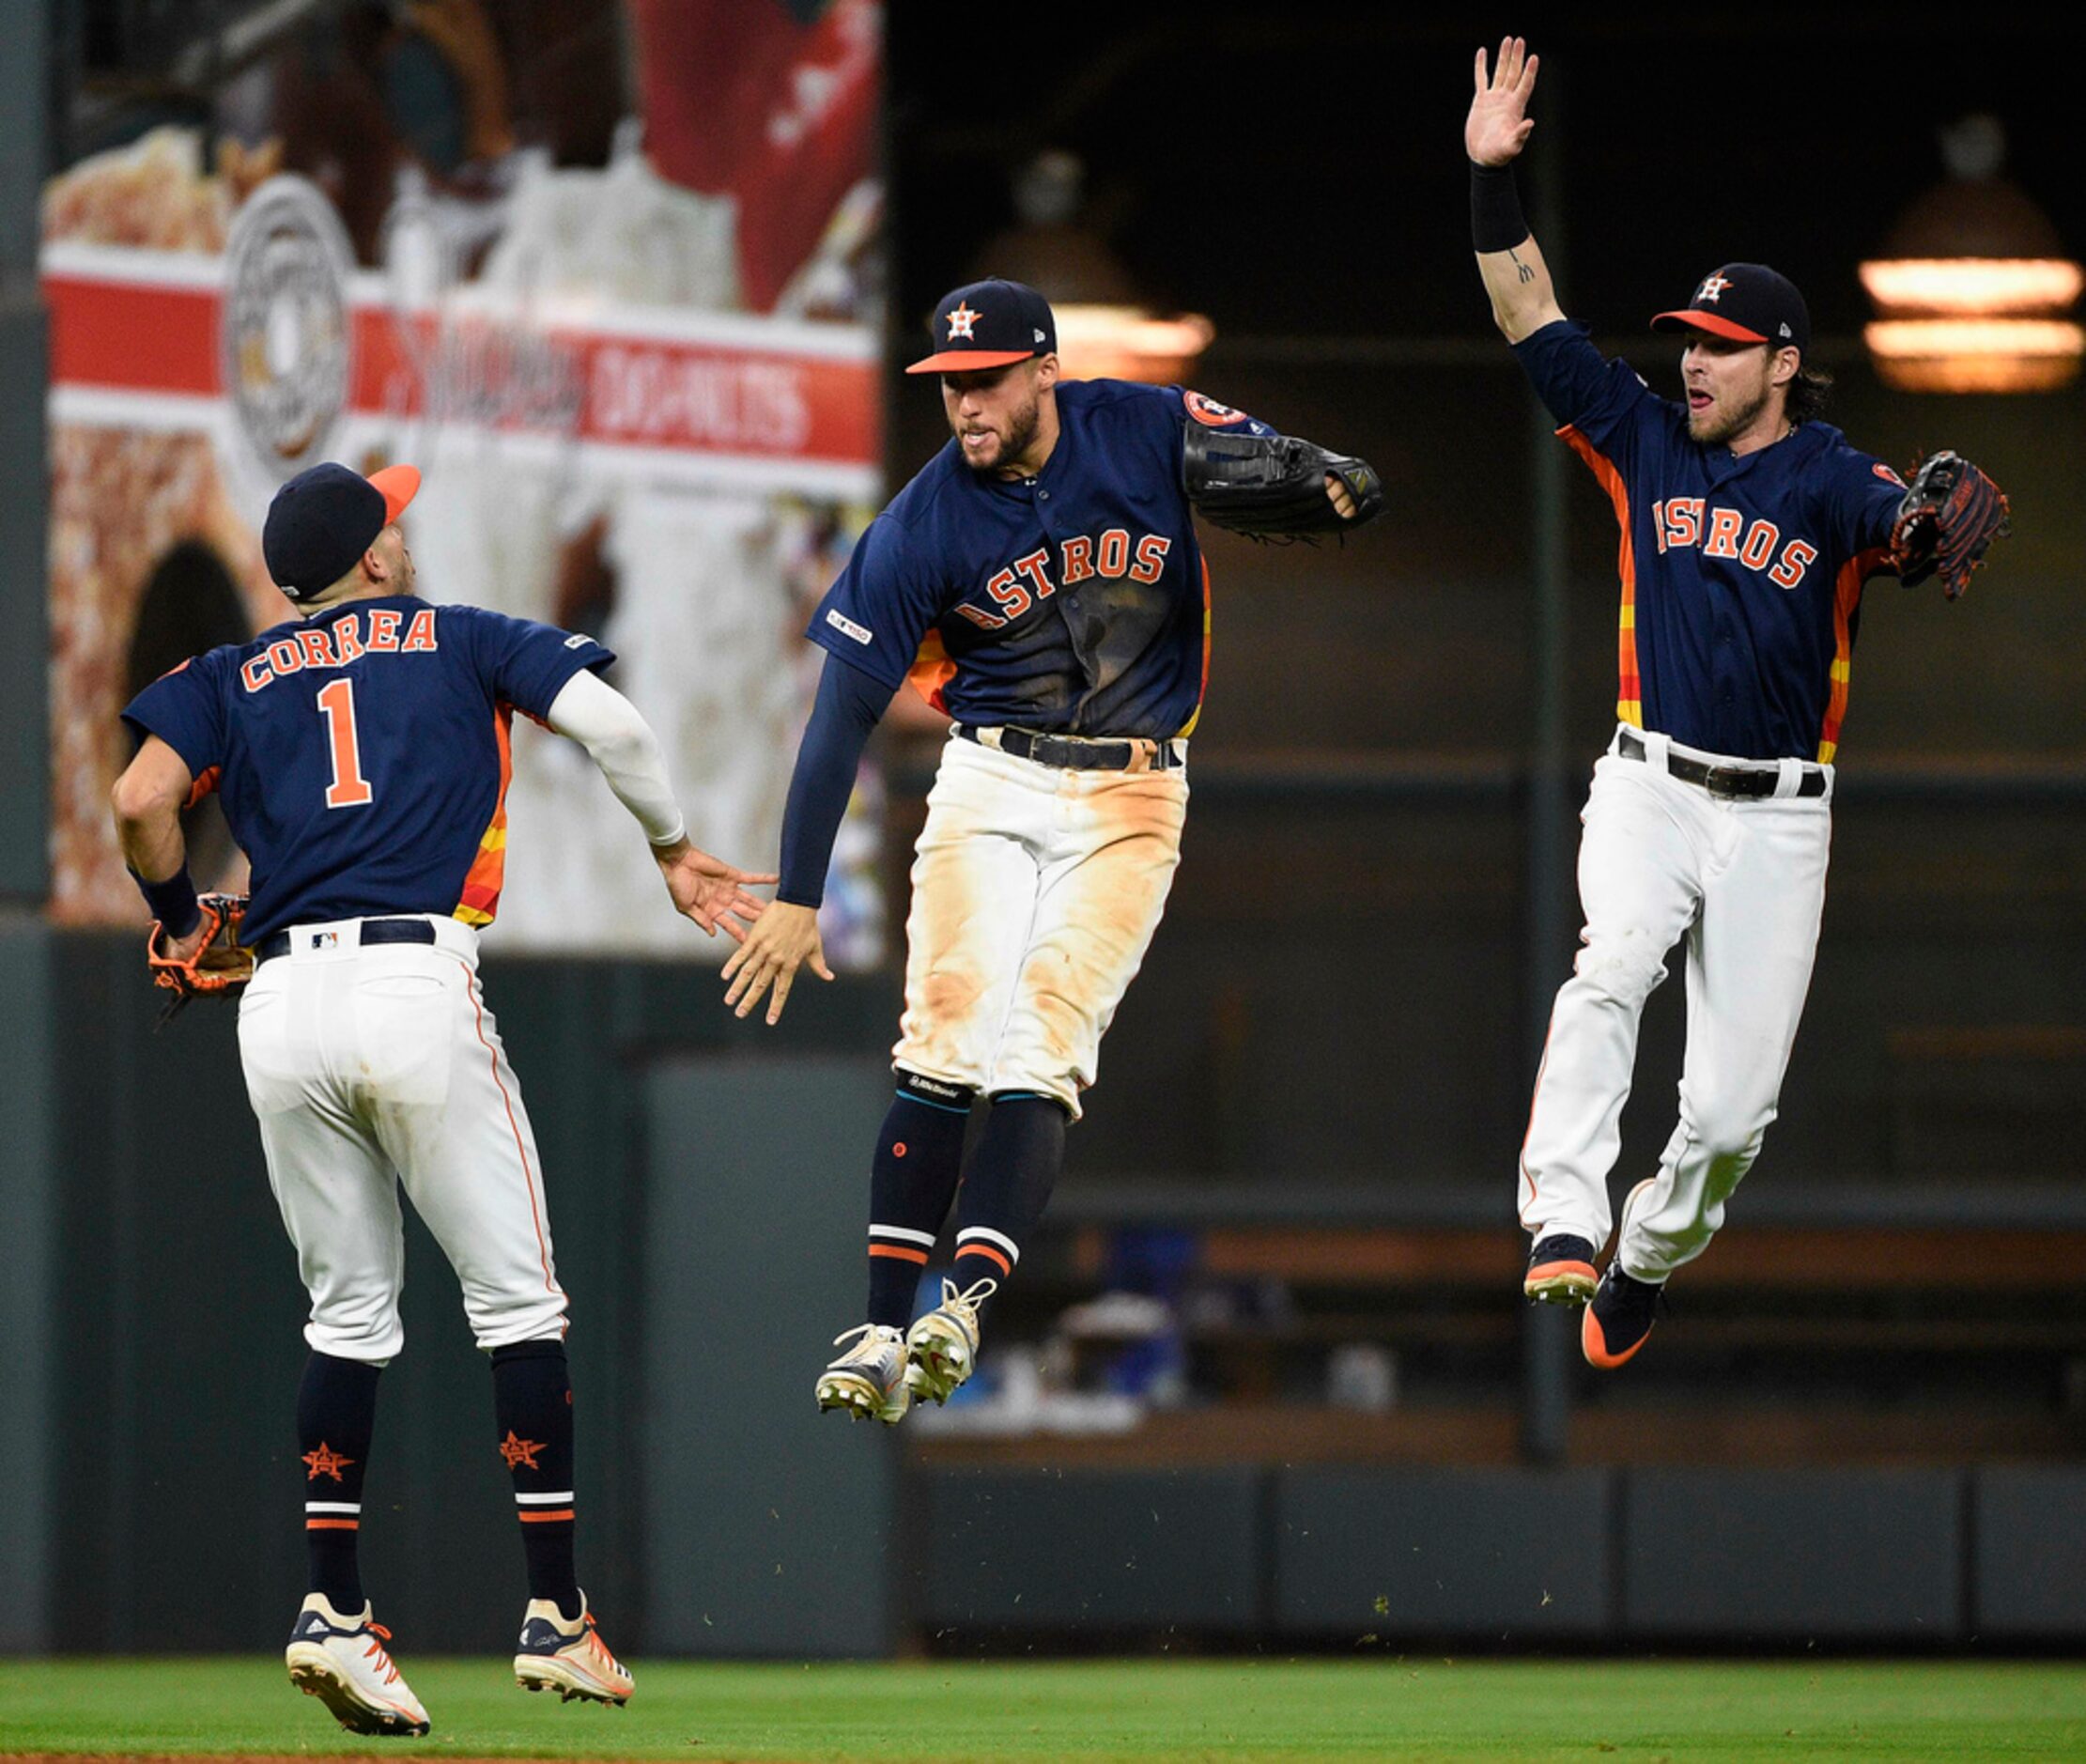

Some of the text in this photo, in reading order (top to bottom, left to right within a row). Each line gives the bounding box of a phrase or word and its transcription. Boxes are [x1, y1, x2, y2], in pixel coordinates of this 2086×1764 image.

[948, 310, 974, 337] H
[1698, 277, 1726, 301] H
[954, 529, 1171, 629] ASTROS
[240, 609, 438, 692] CORREA
[317, 677, 373, 809] 1
